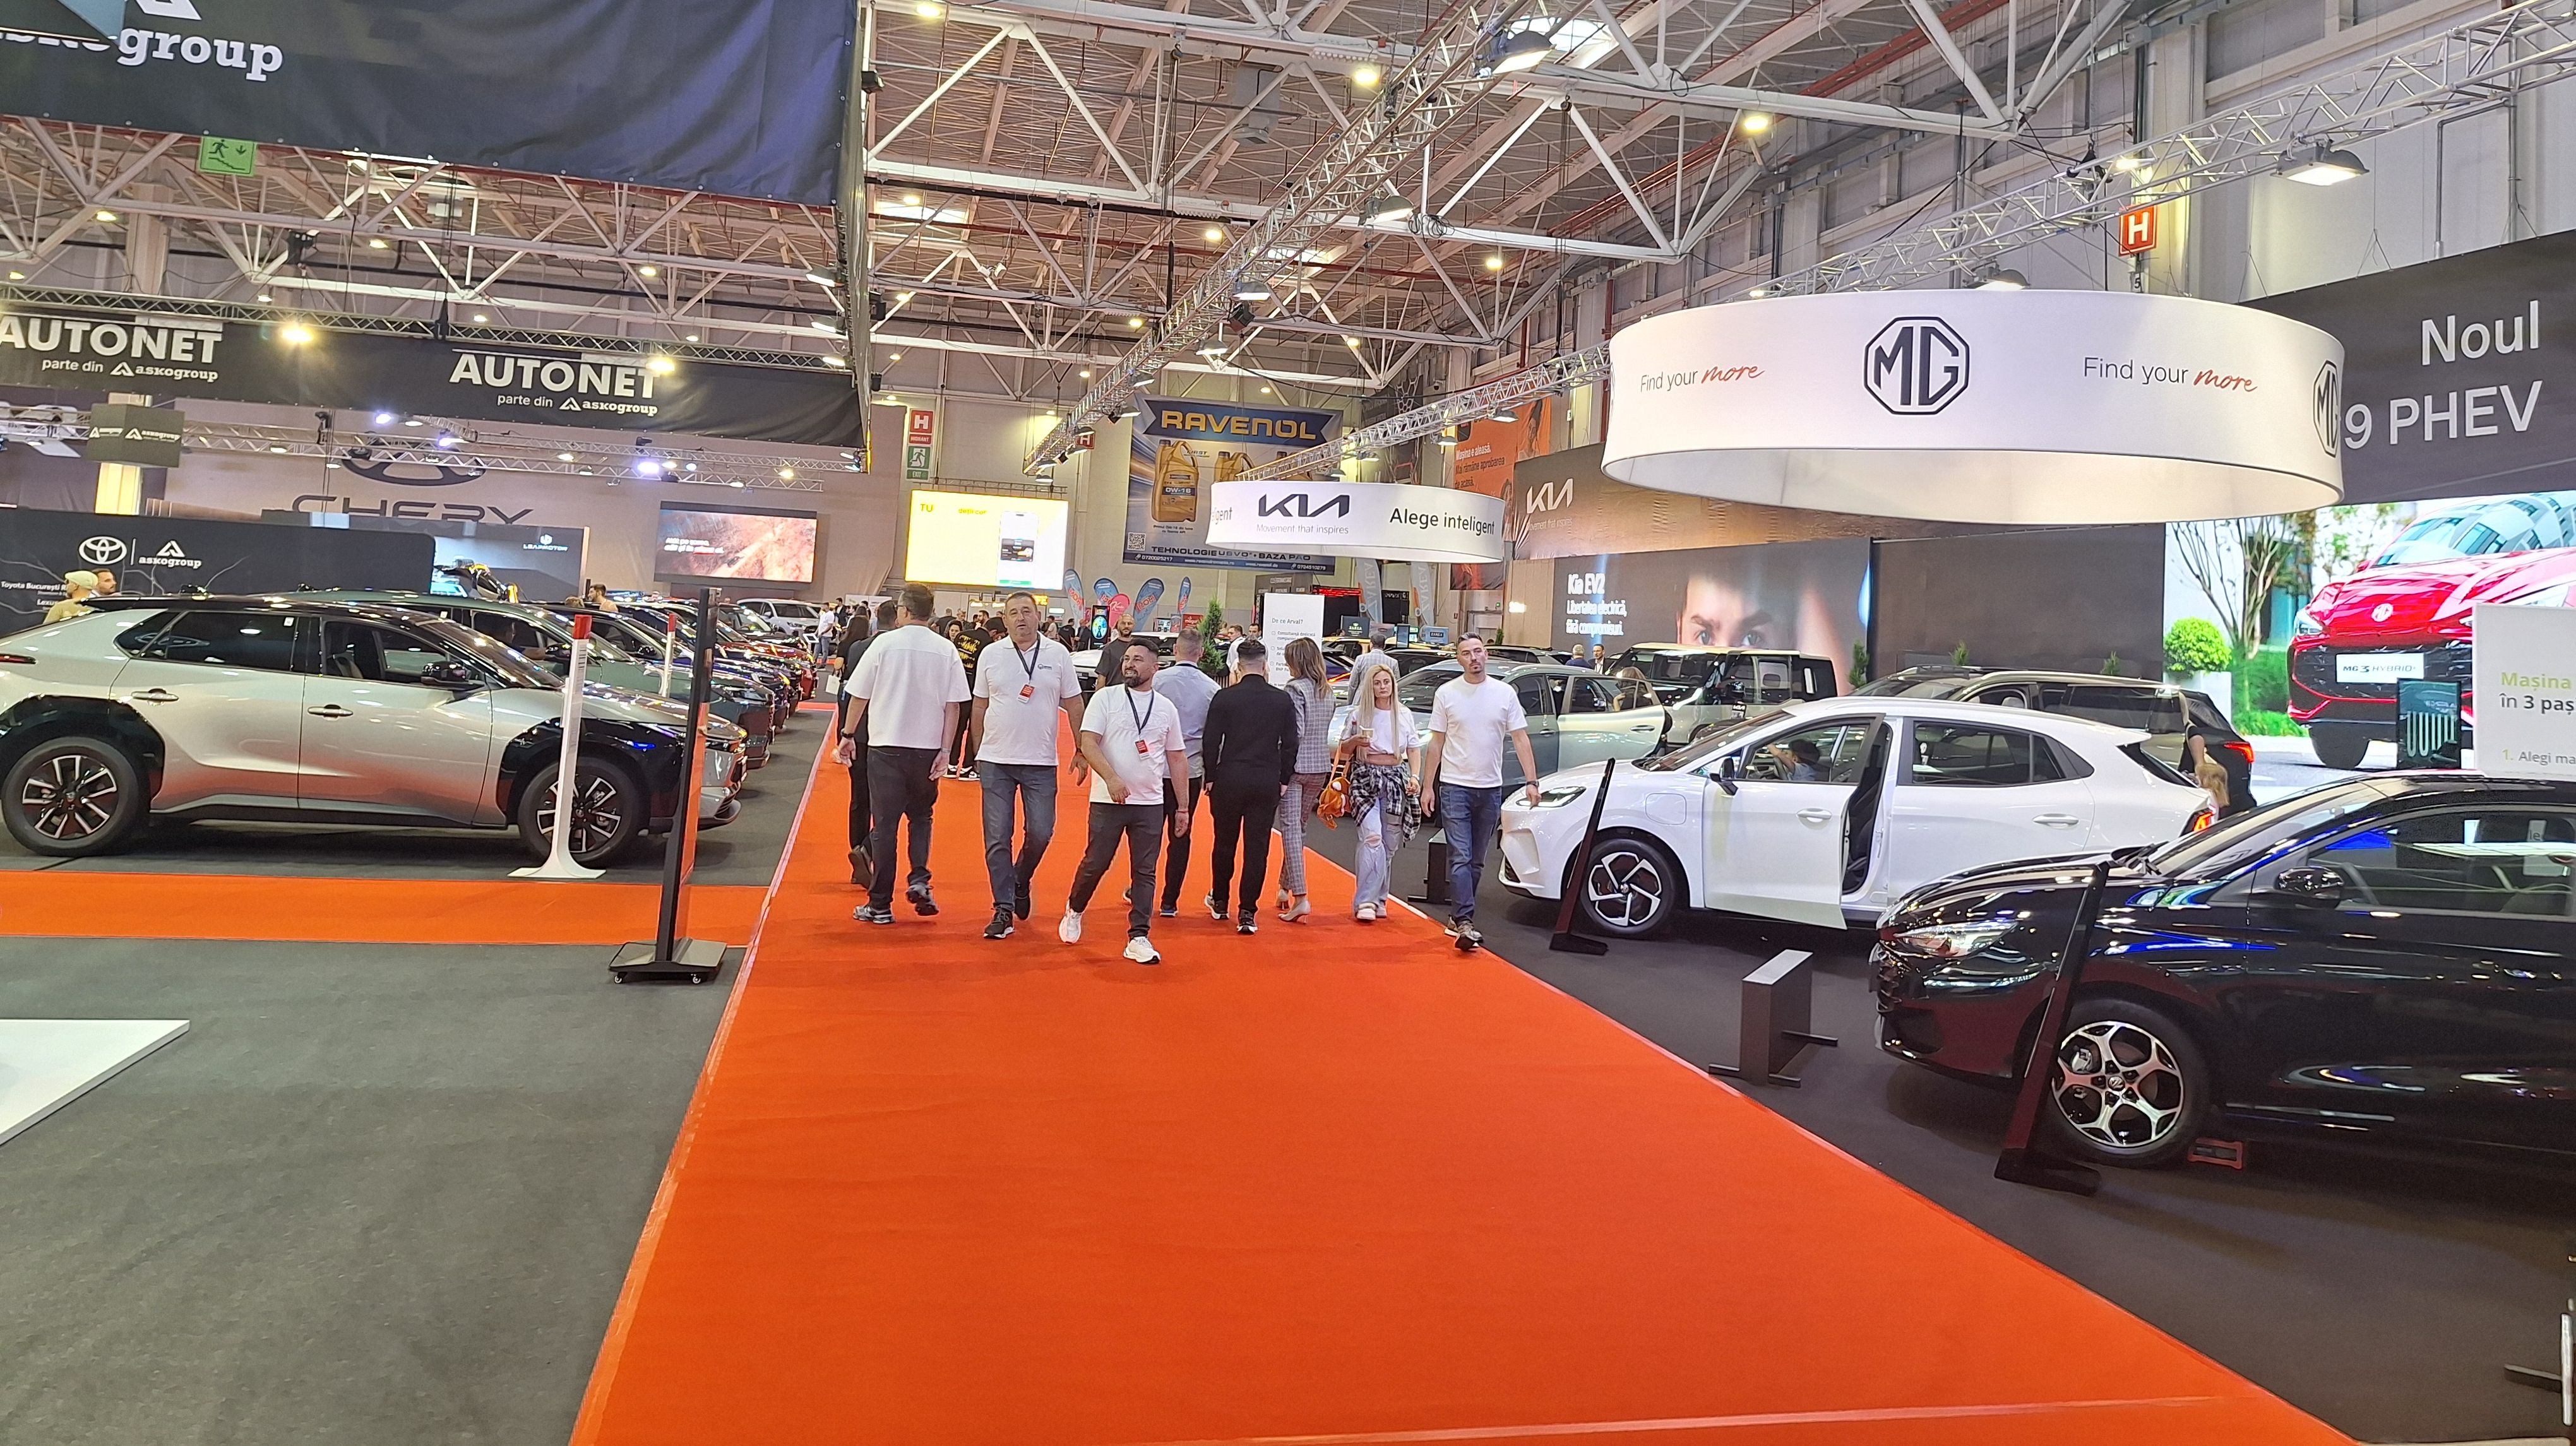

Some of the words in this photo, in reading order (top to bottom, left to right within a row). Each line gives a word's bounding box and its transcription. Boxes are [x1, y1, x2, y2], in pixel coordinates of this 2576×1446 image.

[0, 27, 283, 81] group
[2128, 211, 2149, 245] H
[2134, 278, 2141, 288] 5
[0, 316, 222, 364] AUTONET
[2421, 299, 2539, 367] Noul
[42, 359, 79, 372] parte
[82, 359, 104, 373] din
[135, 365, 218, 382] askogroup
[449, 353, 661, 399] AUTONET
[1873, 325, 1960, 406] MG
[2084, 357, 2133, 380] Find
[2142, 364, 2189, 384] your
[2193, 369, 2258, 393] more
[1640, 371, 1664, 393] Find
[1667, 370, 1698, 391] your
[1701, 365, 1765, 384] more
[497, 394, 530, 406] parte
[534, 396, 553, 408] din
[582, 401, 658, 417] askogroup
[2389, 381, 2543, 444] PHEV
[914, 414, 929, 430] H
[1161, 410, 1316, 441] RAVENOL
[1080, 436, 1090, 446] H
[1258, 493, 1350, 518] KIA
[1527, 478, 1573, 514] KIA
[292, 494, 534, 524] CHERY
[921, 504, 934, 513] TU
[1256, 523, 1295, 533] Movement
[1298, 524, 1313, 533] that
[1317, 524, 1349, 535] inspires
[1390, 507, 1439, 530] Alege
[1444, 512, 1494, 536] inteligent
[138, 555, 202, 569] askogroup
[1151, 545, 1217, 557] TEHNOLOGIE
[1, 581, 25, 590] Toyota
[1567, 573, 1584, 595] Kia
[1585, 572, 1606, 595] EV2
[2501, 672, 2572, 691] Mașina
[2499, 692, 2518, 709] în
[2523, 695, 2534, 709] 3
[2541, 699, 2576, 716] paș
[2502, 749, 2513, 761] 1.
[2519, 750, 2551, 766] Alegi
